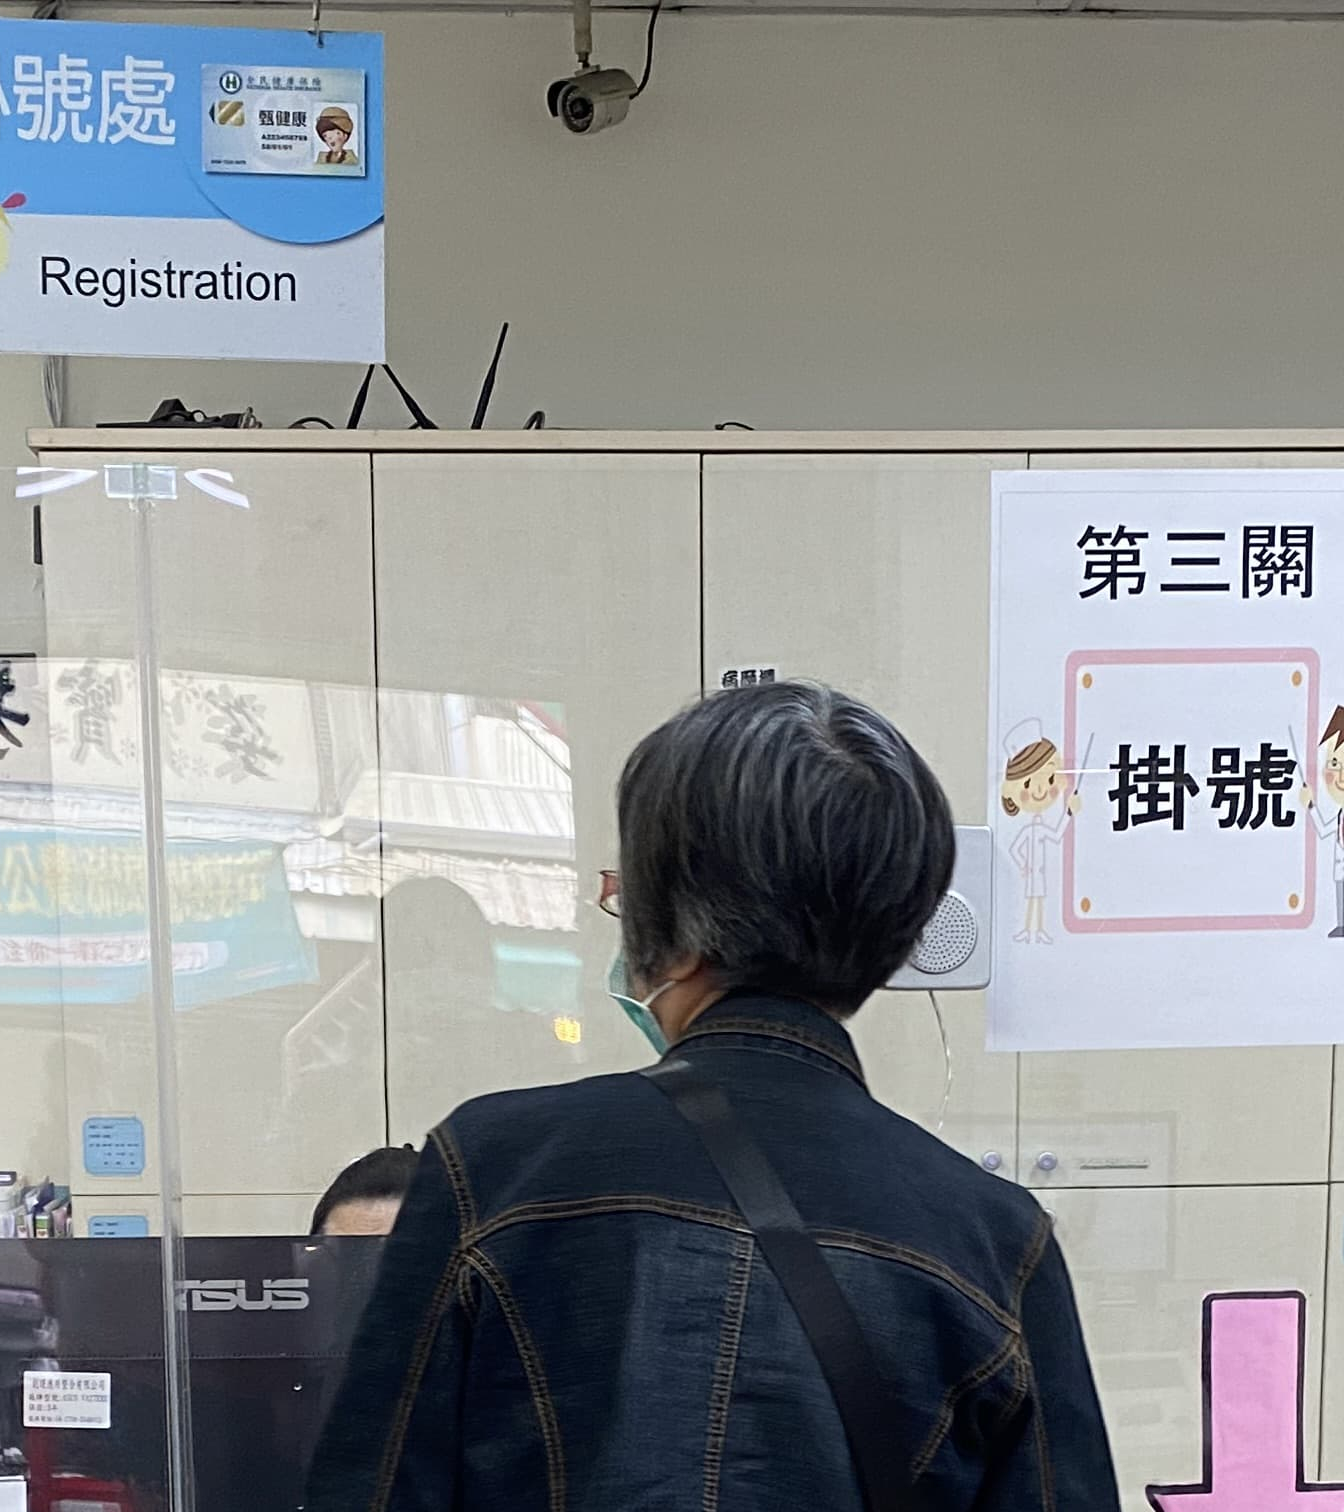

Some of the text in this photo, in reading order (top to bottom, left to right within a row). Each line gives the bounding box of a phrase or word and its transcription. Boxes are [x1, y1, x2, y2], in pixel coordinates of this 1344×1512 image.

[258, 110, 308, 128] 甄健康
[40, 255, 298, 307] Registration
[1075, 524, 1315, 601] 第三關
[1107, 742, 1299, 832] 掛號
